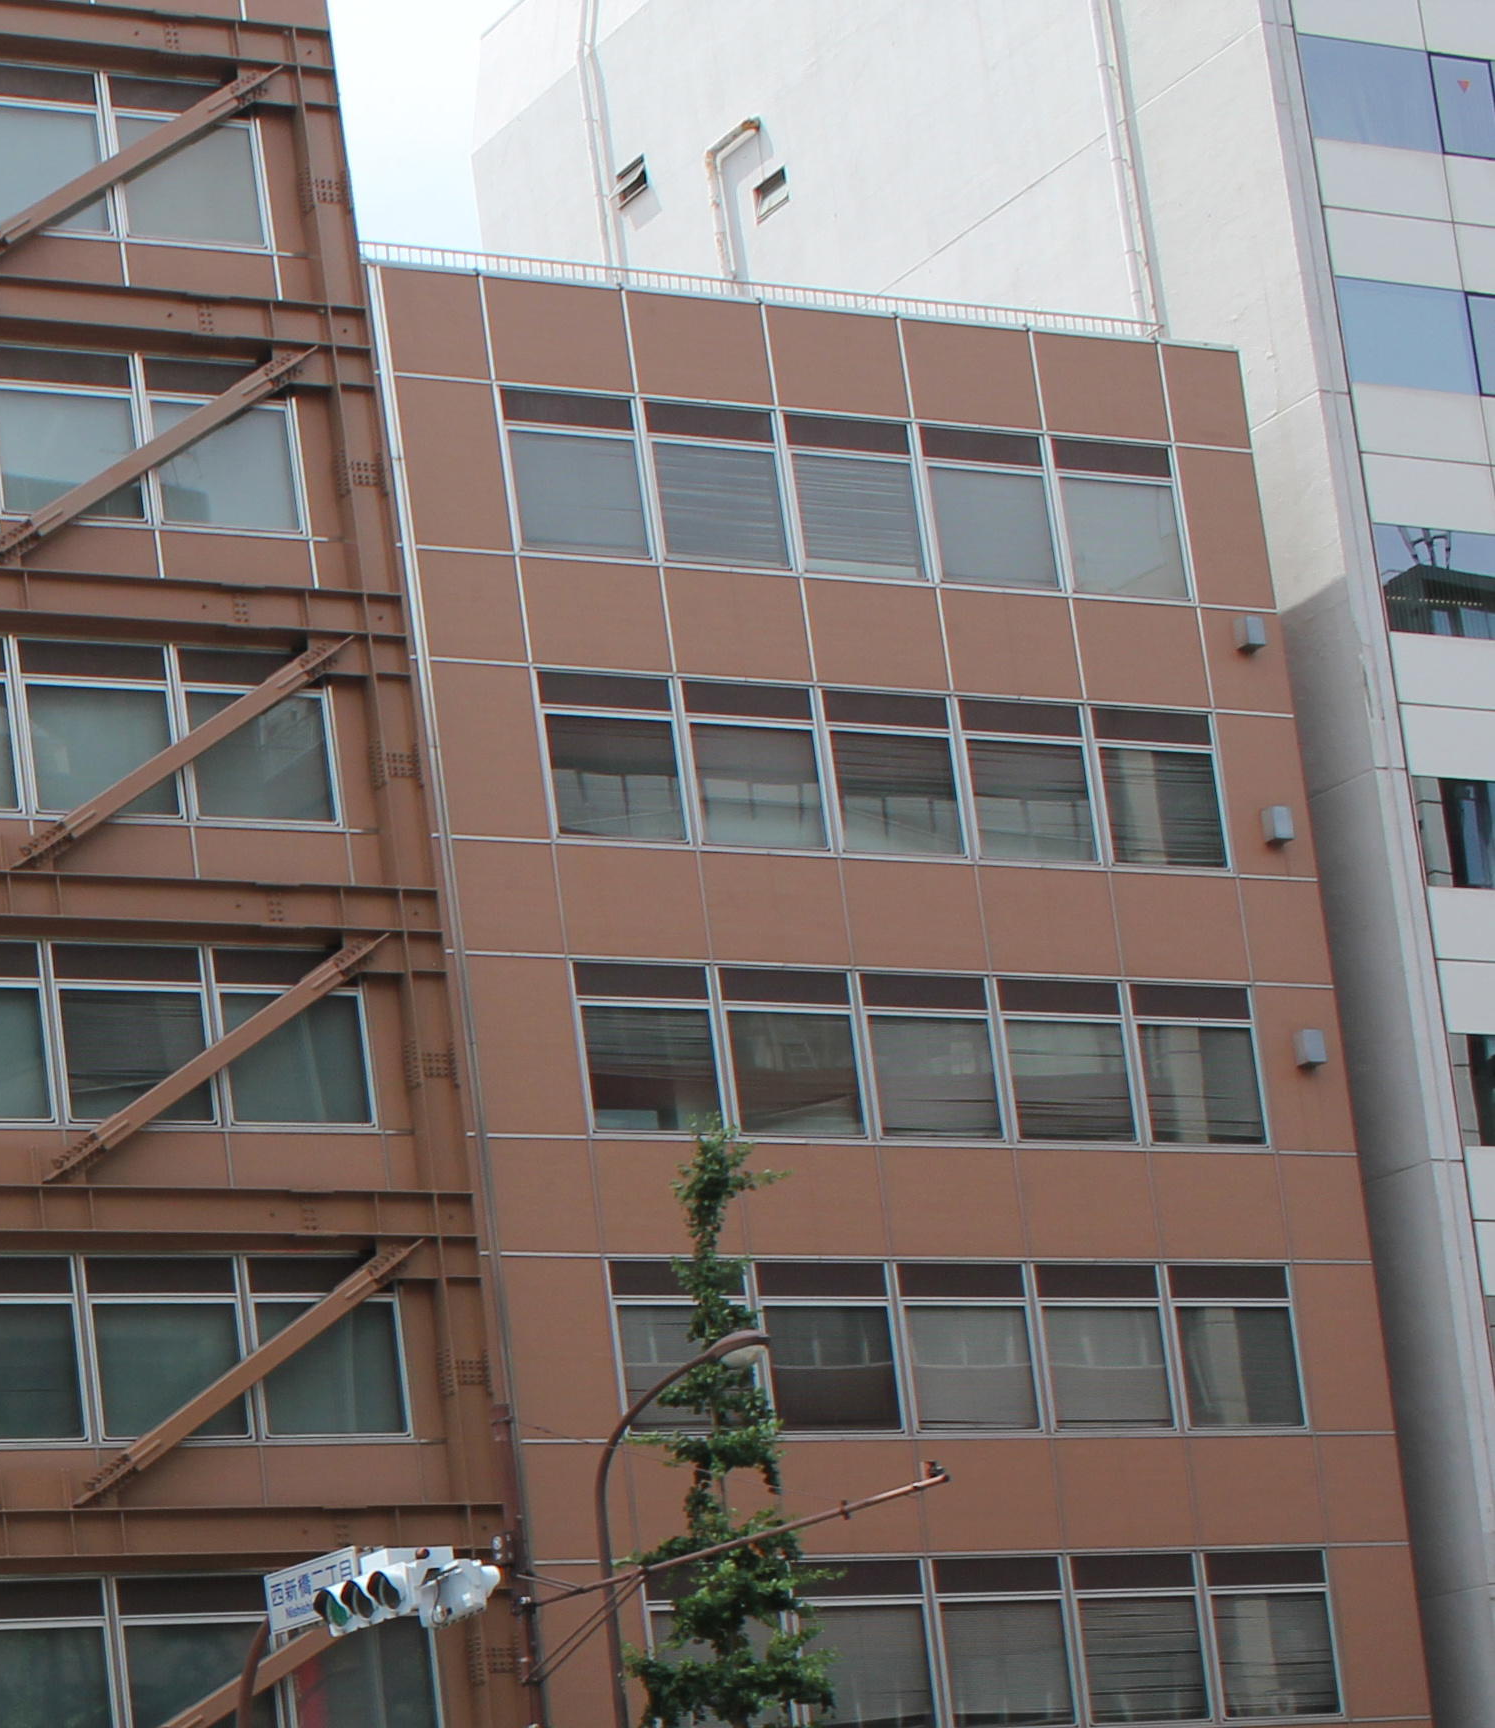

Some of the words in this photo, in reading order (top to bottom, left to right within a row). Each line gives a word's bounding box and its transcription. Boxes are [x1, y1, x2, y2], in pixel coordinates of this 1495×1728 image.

[269, 1559, 353, 1607] 西新橋二丁目
